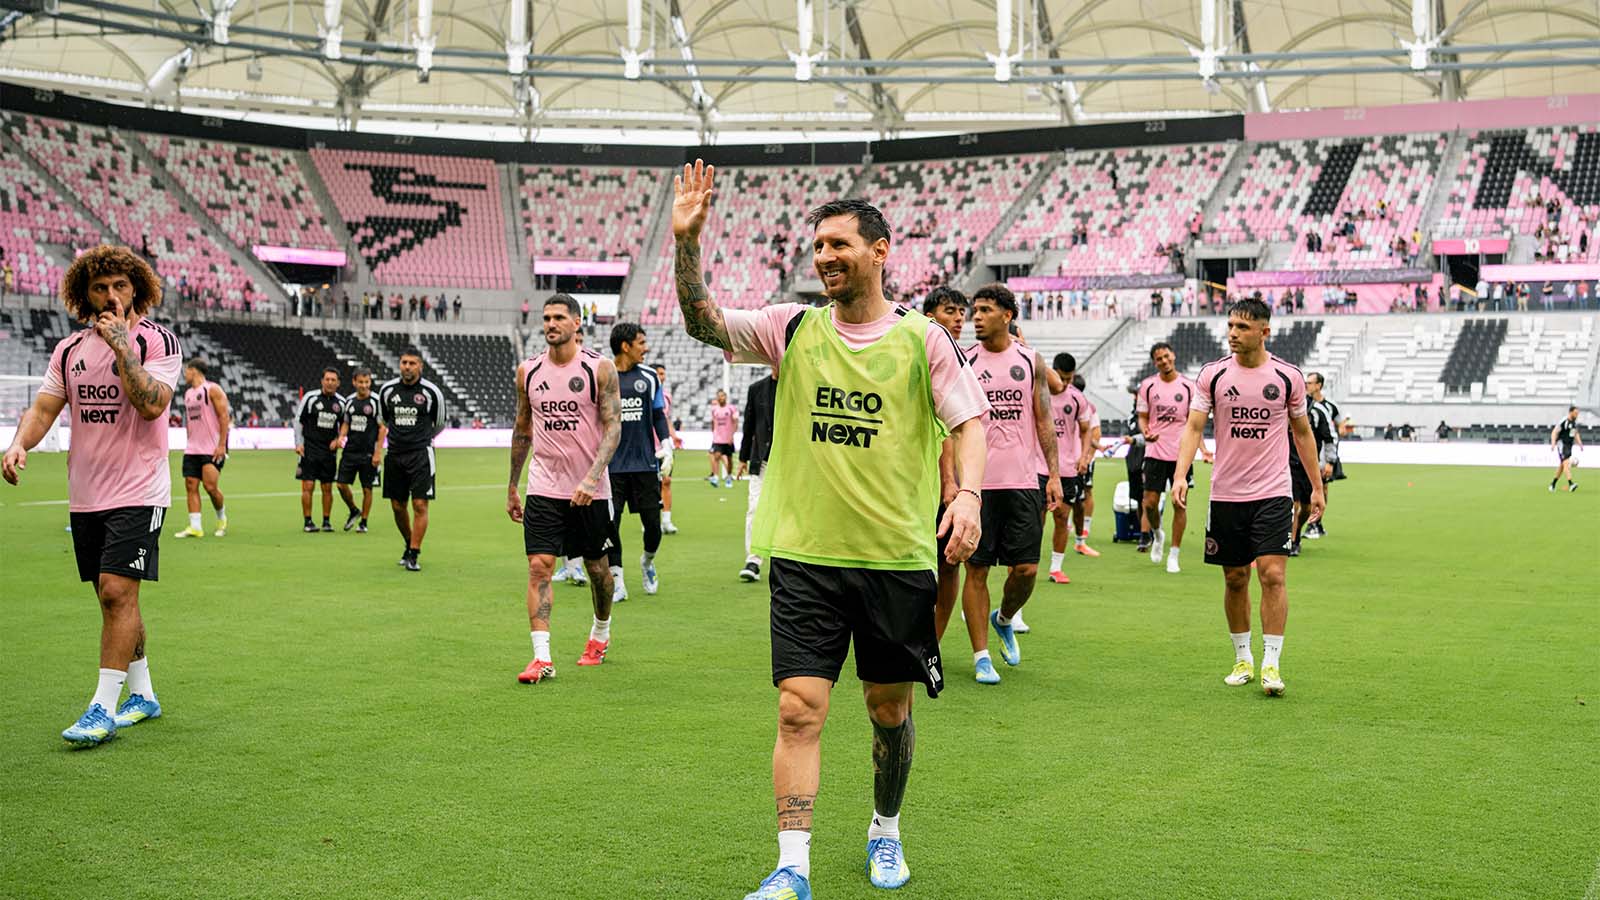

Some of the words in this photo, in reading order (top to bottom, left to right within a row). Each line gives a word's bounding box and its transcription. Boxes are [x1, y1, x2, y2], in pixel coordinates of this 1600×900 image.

[1145, 120, 1166, 132] 223
[958, 134, 979, 145] 224
[1464, 239, 1480, 254] 10
[78, 384, 119, 400] ERGO
[987, 389, 1023, 402] ERGO
[541, 400, 578, 412] ERGO
[620, 397, 643, 408] RGO
[816, 386, 883, 414] ERGO
[80, 409, 120, 424] NeXT
[395, 406, 418, 416] ERGO
[1231, 407, 1271, 420] ERGO
[544, 419, 579, 431] NeXT
[811, 421, 878, 449] NeXT
[1230, 426, 1268, 439] NeXT
[138, 547, 148, 556] 37
[927, 655, 938, 667] 10
